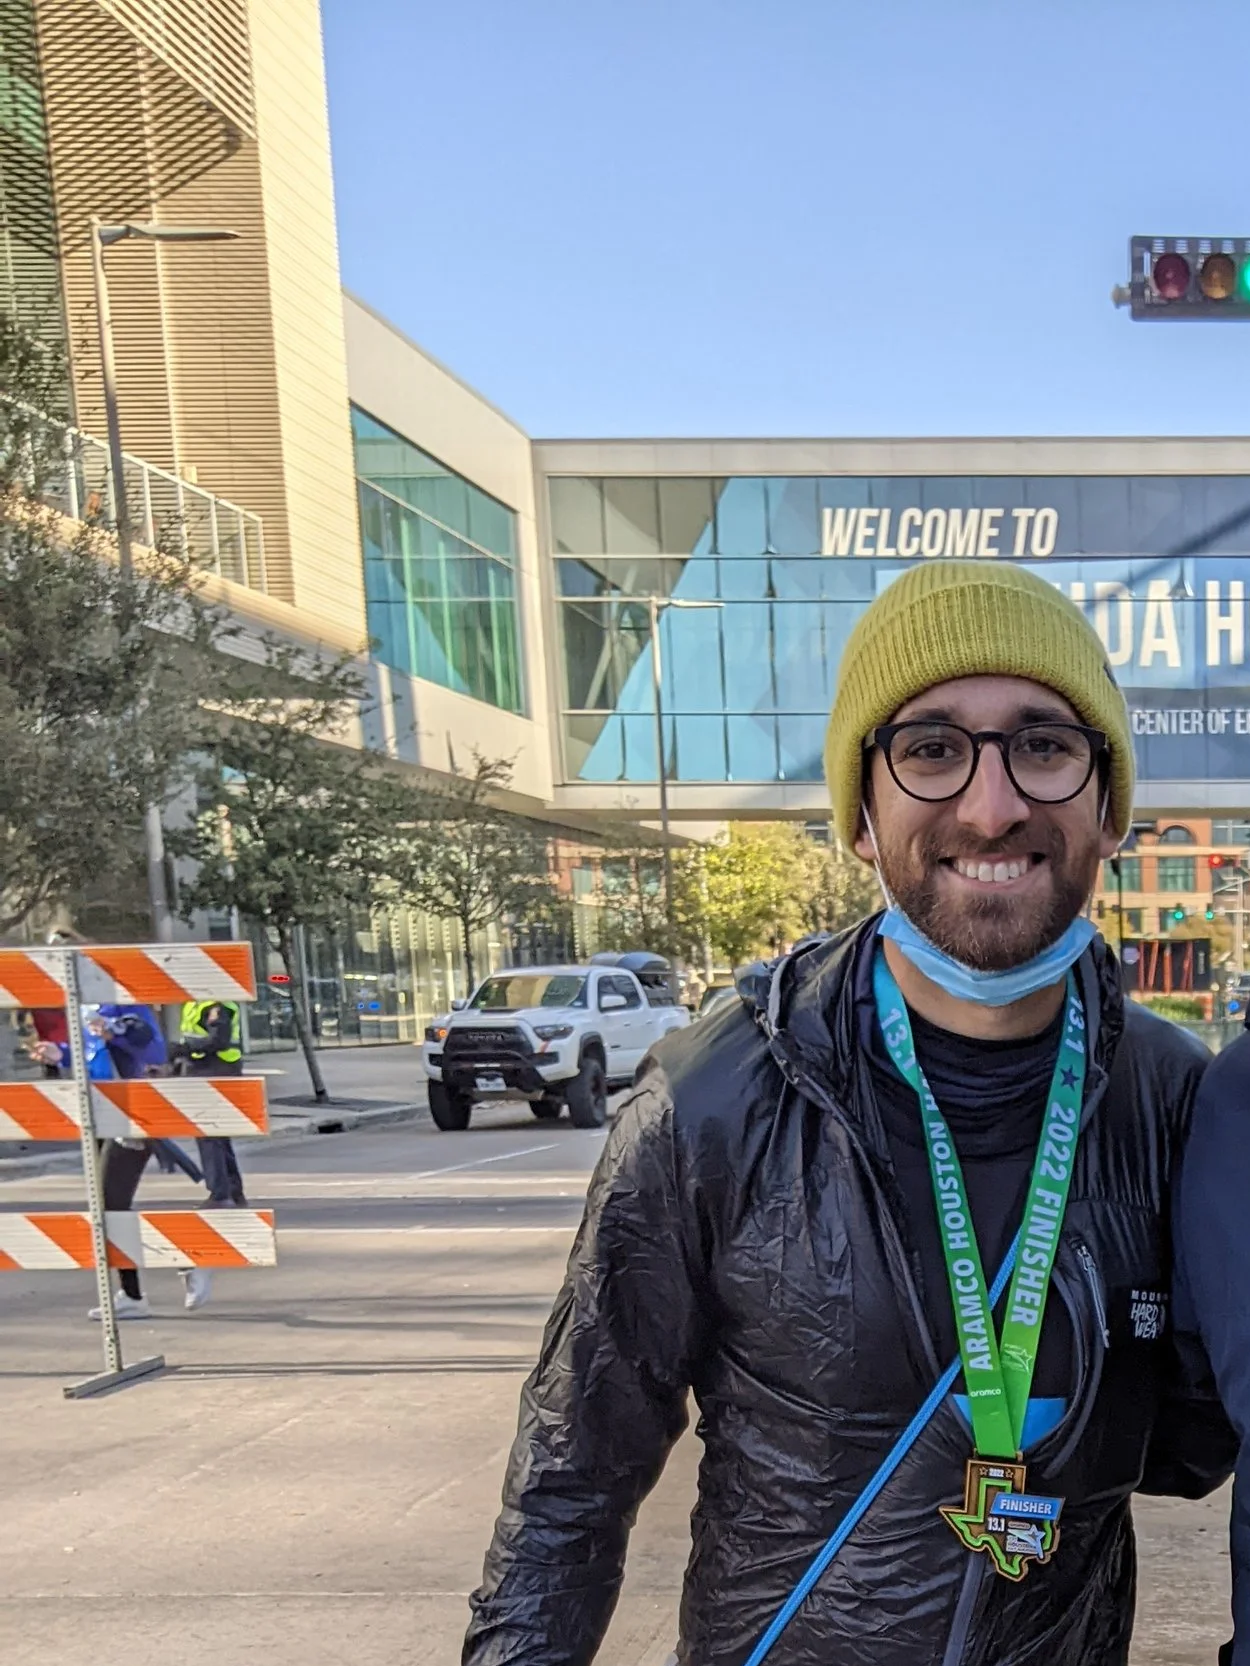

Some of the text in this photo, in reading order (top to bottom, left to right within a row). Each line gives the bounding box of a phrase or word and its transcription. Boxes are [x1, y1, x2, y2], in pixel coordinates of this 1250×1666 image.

[821, 507, 1058, 557] WELCOME TO
[1131, 708, 1204, 735] CENTER
[1207, 708, 1231, 735] OF
[881, 1007, 916, 1071] 13.1
[1039, 1101, 1076, 1181] 2022
[928, 1122, 970, 1250] HOUSTON
[1011, 1187, 1062, 1327] FINISHER
[953, 1258, 993, 1371] ARAMCO
[1130, 1302, 1159, 1323] HARD
[970, 1388, 1001, 1398] aramco
[987, 1516, 1006, 1532] 13.1
[1000, 1498, 1052, 1514] FINISHER
